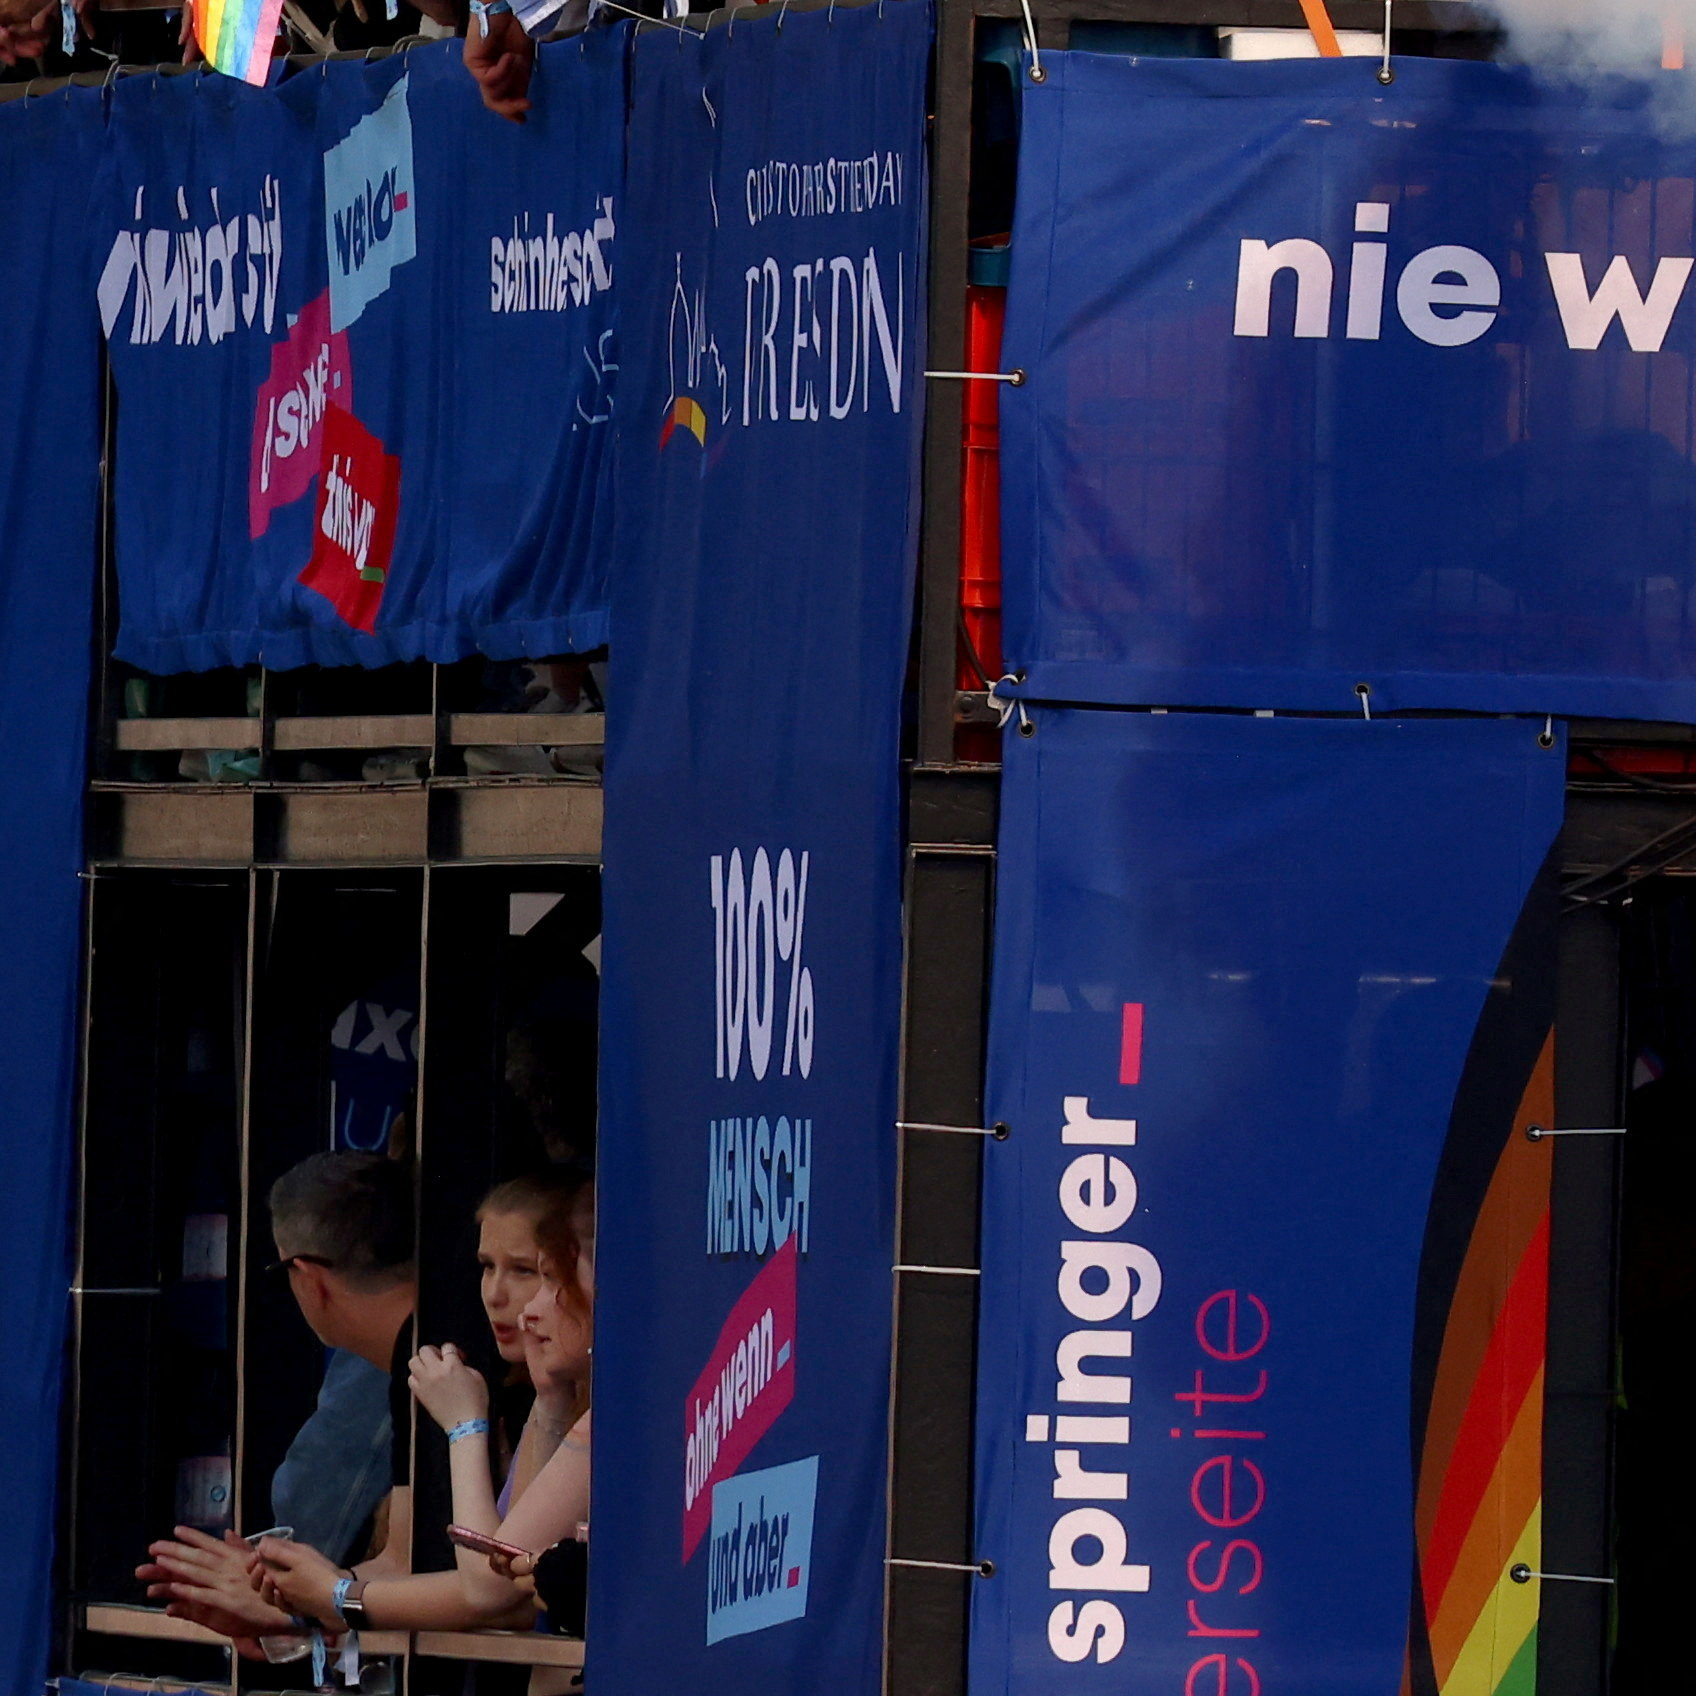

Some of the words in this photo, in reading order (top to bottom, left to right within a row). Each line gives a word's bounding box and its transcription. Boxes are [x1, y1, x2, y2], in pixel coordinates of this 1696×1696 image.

[1234, 202, 1502, 348] nie
[711, 846, 815, 1082] 100%
[706, 1115, 812, 1255] MENSCH
[685, 1385, 720, 1511] ohne
[720, 1307, 773, 1440] wenn
[1025, 1096, 1163, 1664] springer
[711, 1501, 743, 1616] und
[742, 1494, 790, 1602] aber
